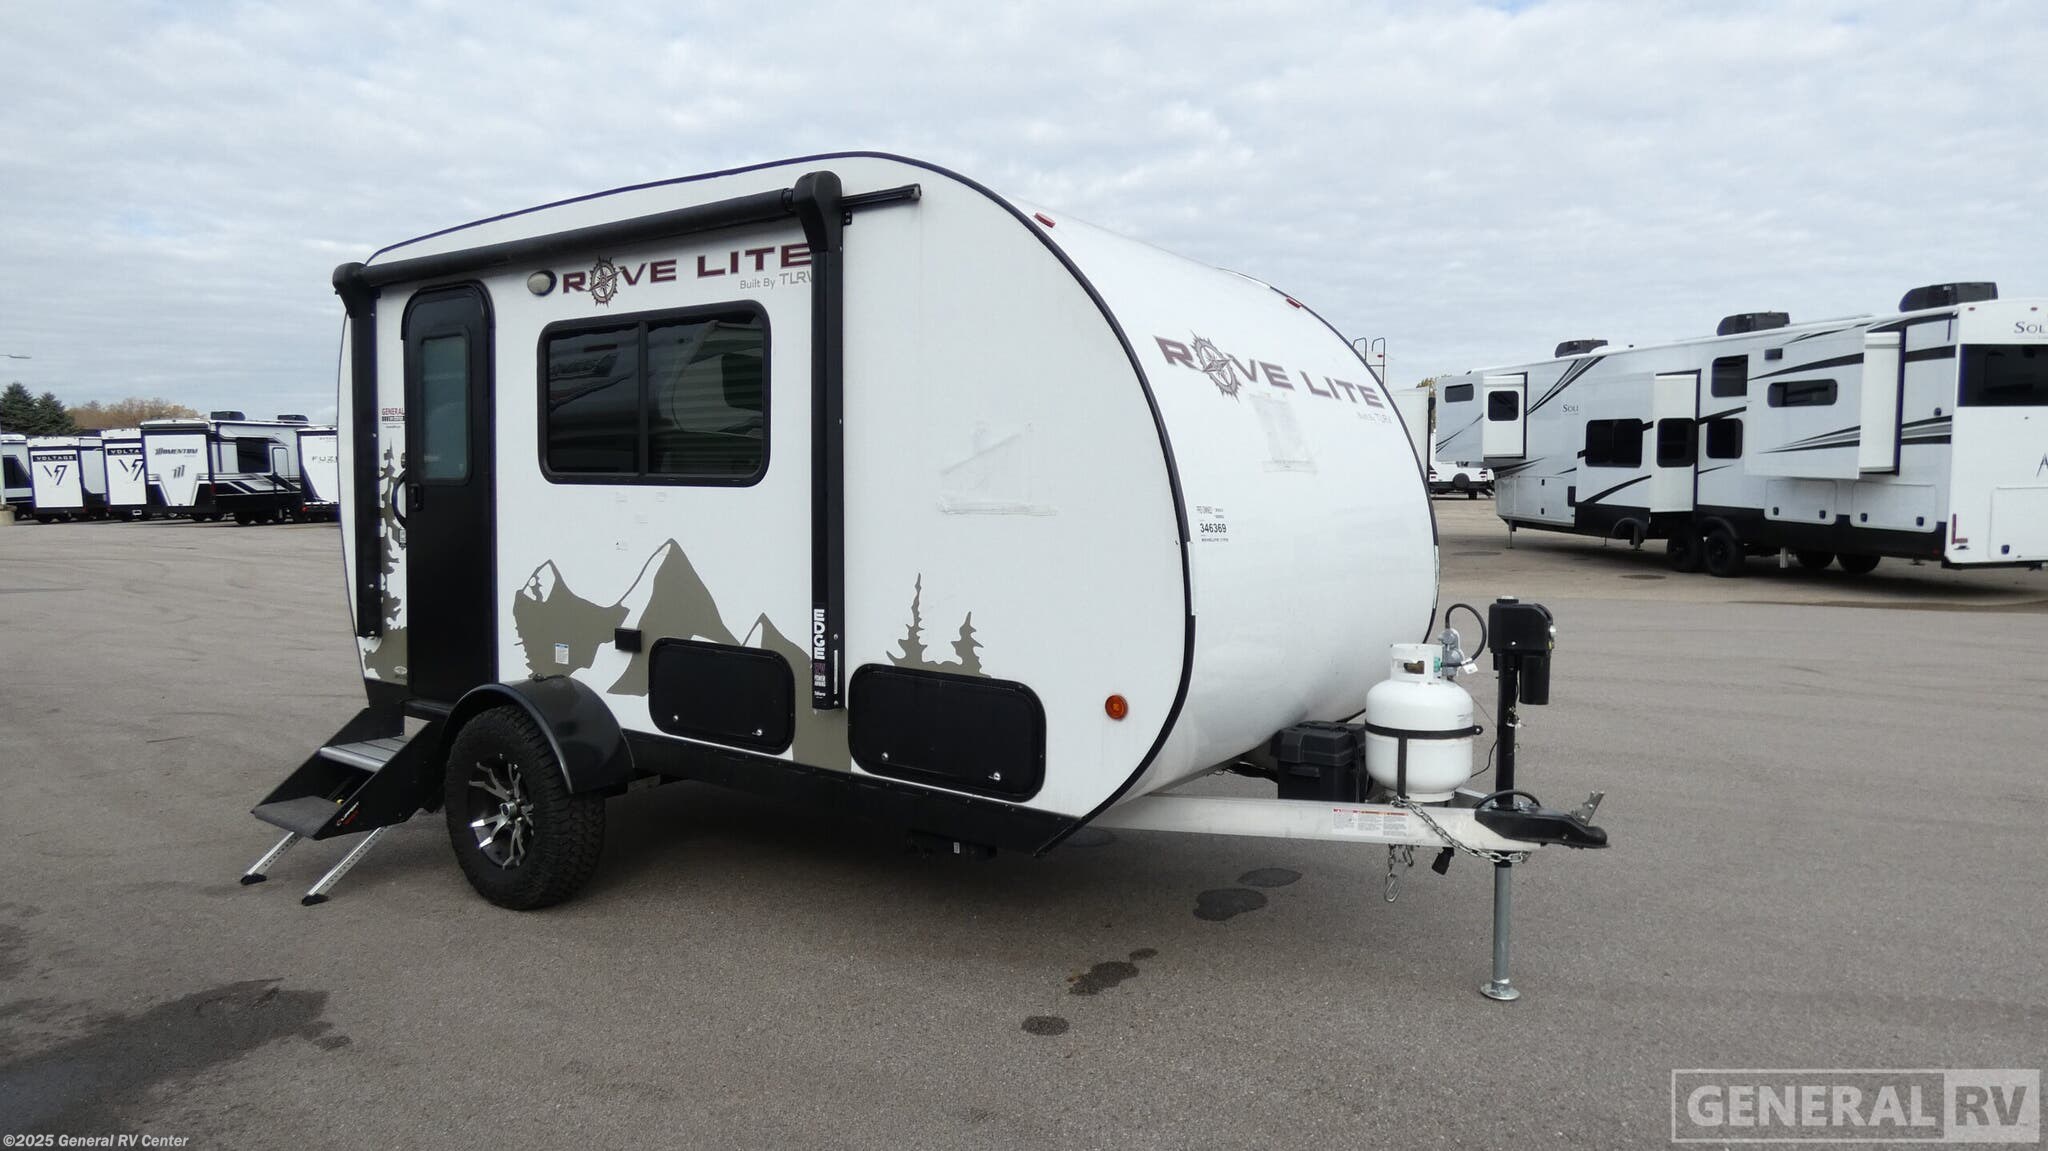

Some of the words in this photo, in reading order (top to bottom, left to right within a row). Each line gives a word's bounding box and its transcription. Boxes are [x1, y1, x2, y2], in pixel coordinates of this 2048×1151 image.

[697, 242, 812, 279] LITE
[740, 279, 761, 290] Built
[763, 277, 776, 290] By
[1300, 370, 1385, 408] LITE
[813, 608, 826, 661] EDGE
